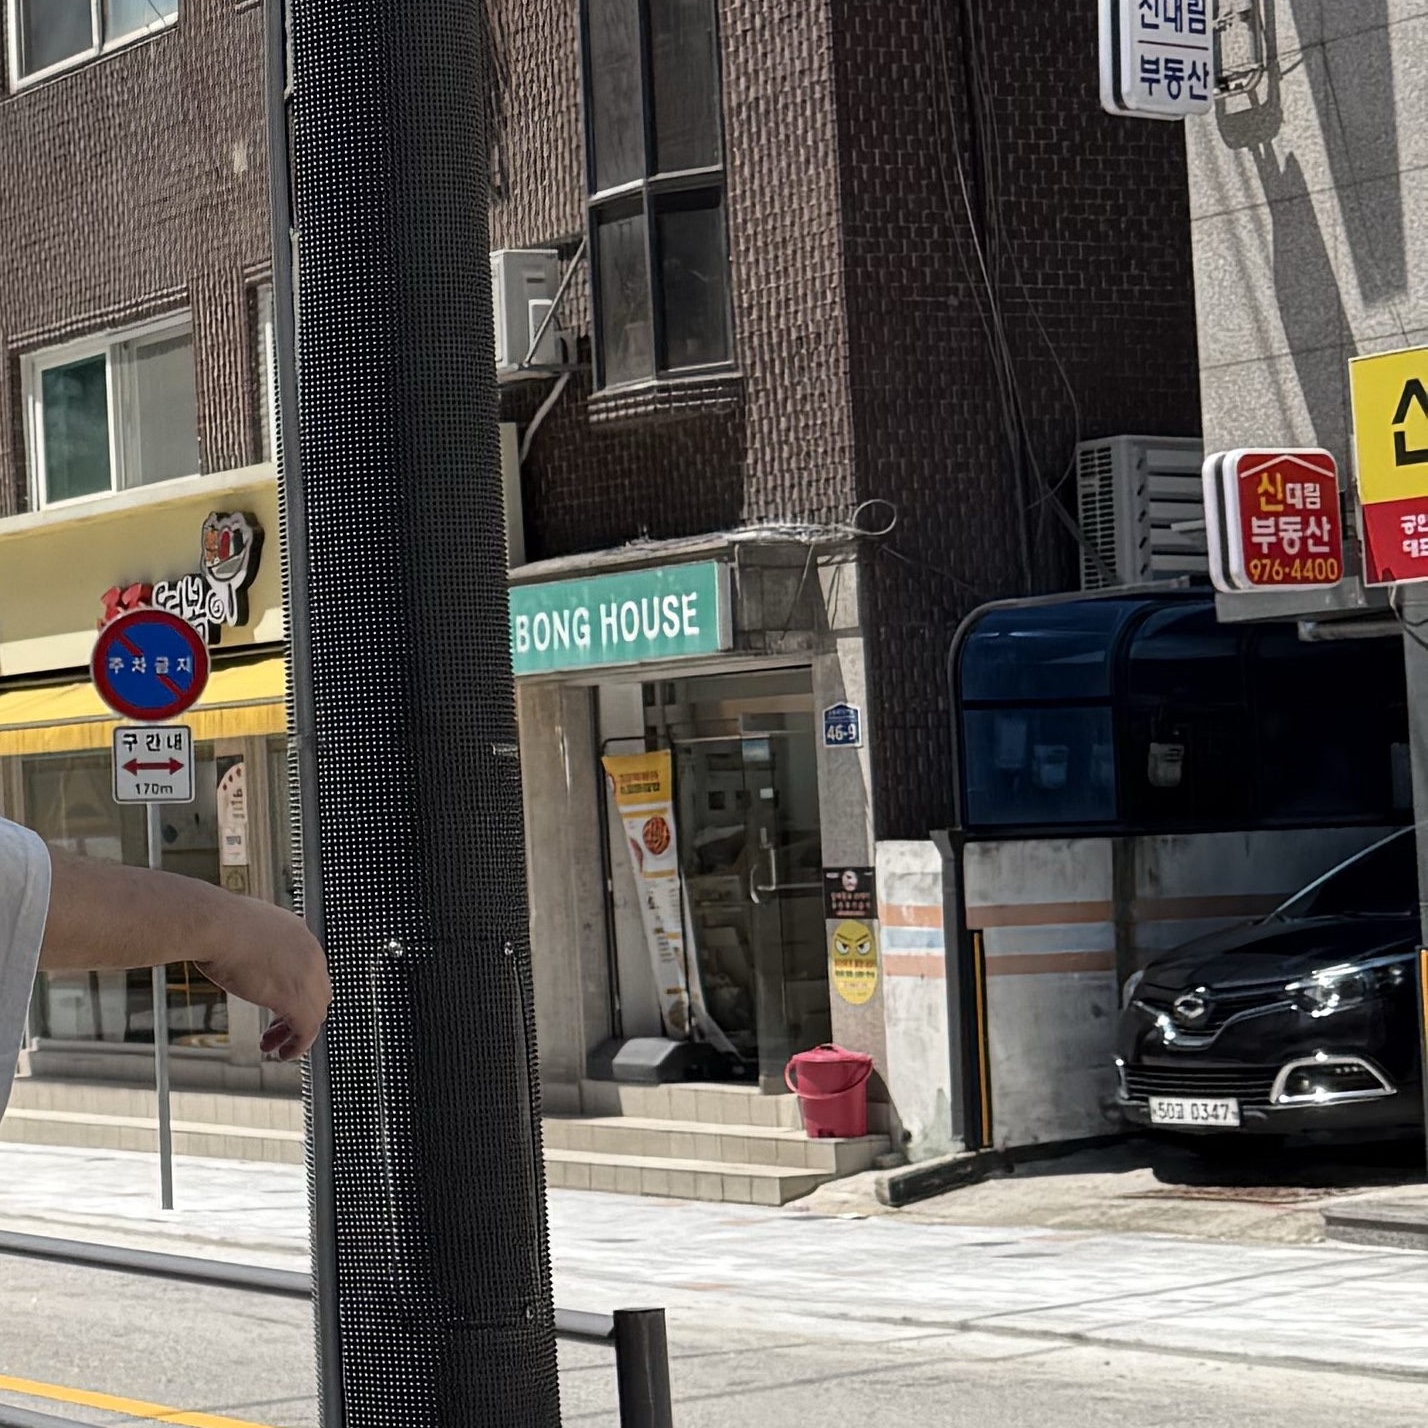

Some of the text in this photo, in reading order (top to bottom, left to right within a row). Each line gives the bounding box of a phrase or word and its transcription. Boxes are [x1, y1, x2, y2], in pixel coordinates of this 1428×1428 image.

[1140, 54, 1210, 101] 부동산
[1257, 473, 1321, 512] 신대림
[1251, 516, 1331, 555] 부동산
[599, 592, 700, 645] HOUSE
[827, 723, 857, 740] 46-9
[135, 783, 174, 795] 170m
